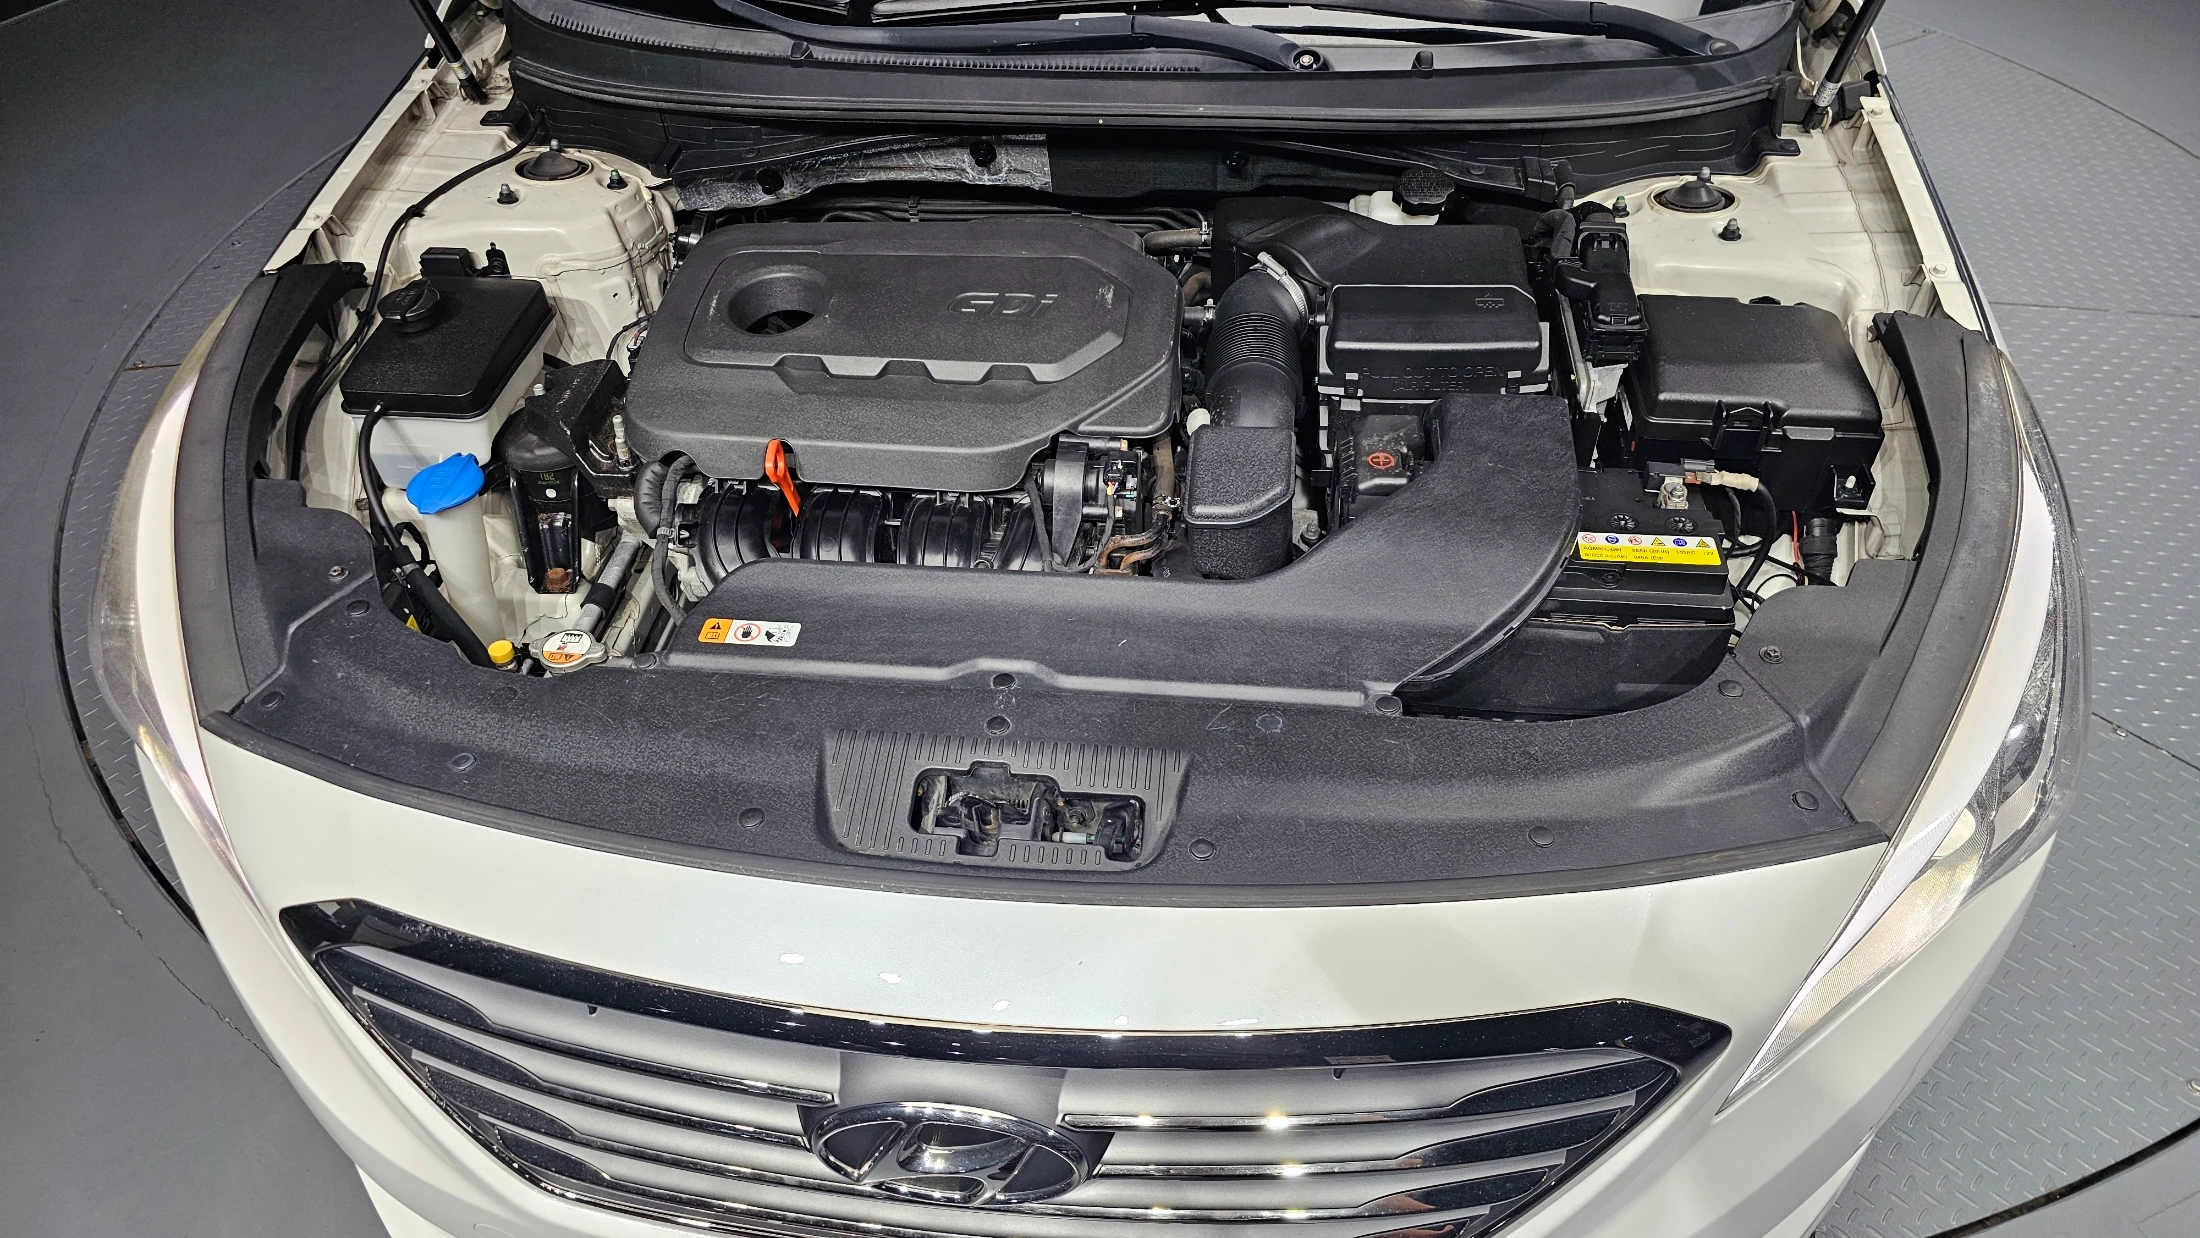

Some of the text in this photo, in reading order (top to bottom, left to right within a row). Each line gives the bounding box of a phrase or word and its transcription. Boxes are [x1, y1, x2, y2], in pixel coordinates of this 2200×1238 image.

[1360, 365, 1505, 379] PULL OUT TO OPEN
